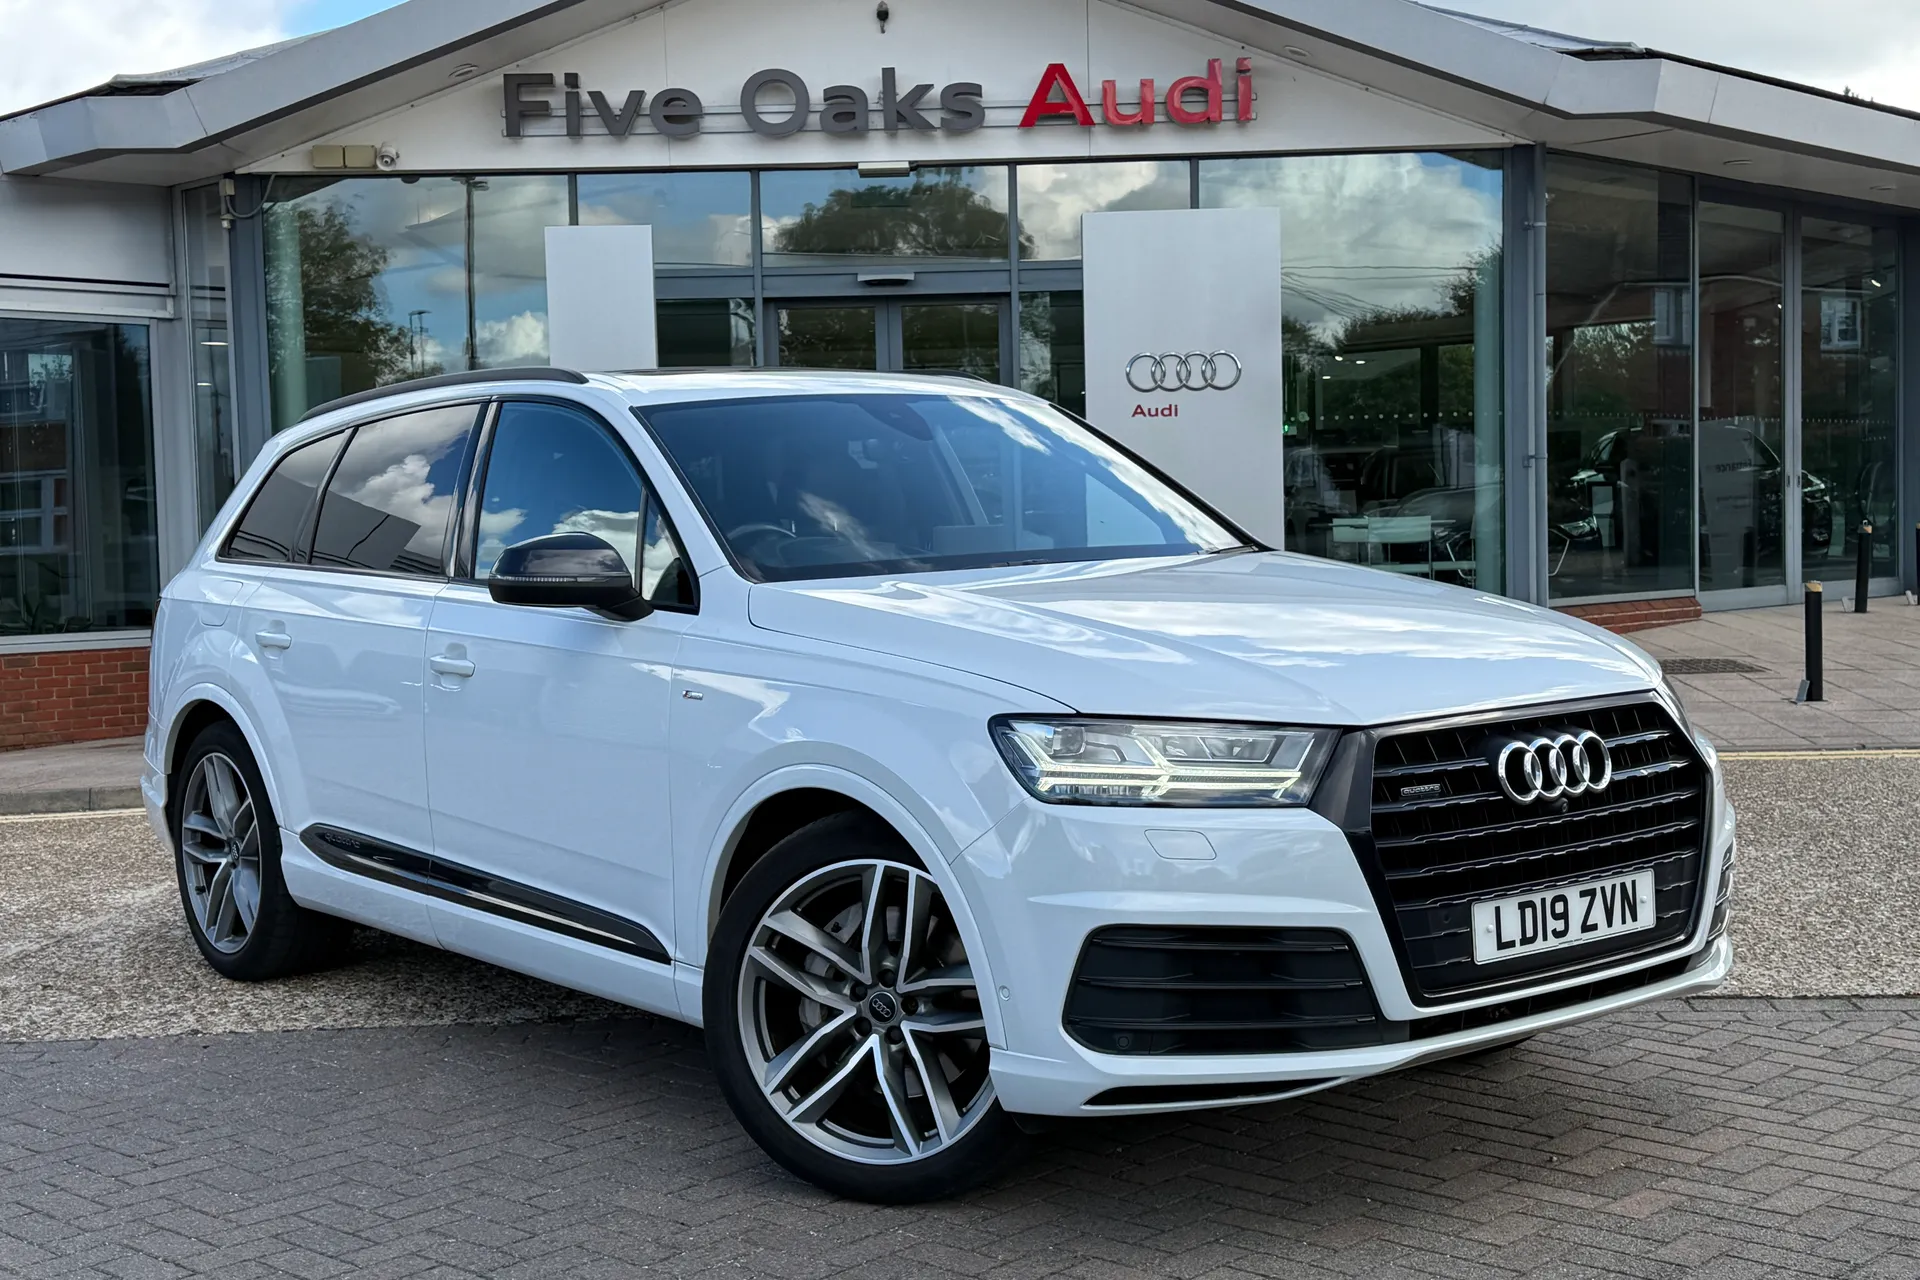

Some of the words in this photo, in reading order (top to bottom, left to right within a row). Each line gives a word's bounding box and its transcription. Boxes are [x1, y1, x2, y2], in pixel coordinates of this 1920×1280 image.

[503, 73, 703, 138] Five
[740, 67, 984, 136] Oaks
[1018, 57, 1254, 129] Audi
[1131, 403, 1179, 417] Audi
[1494, 894, 1570, 951] LD19
[1579, 879, 1638, 934] ZVN
